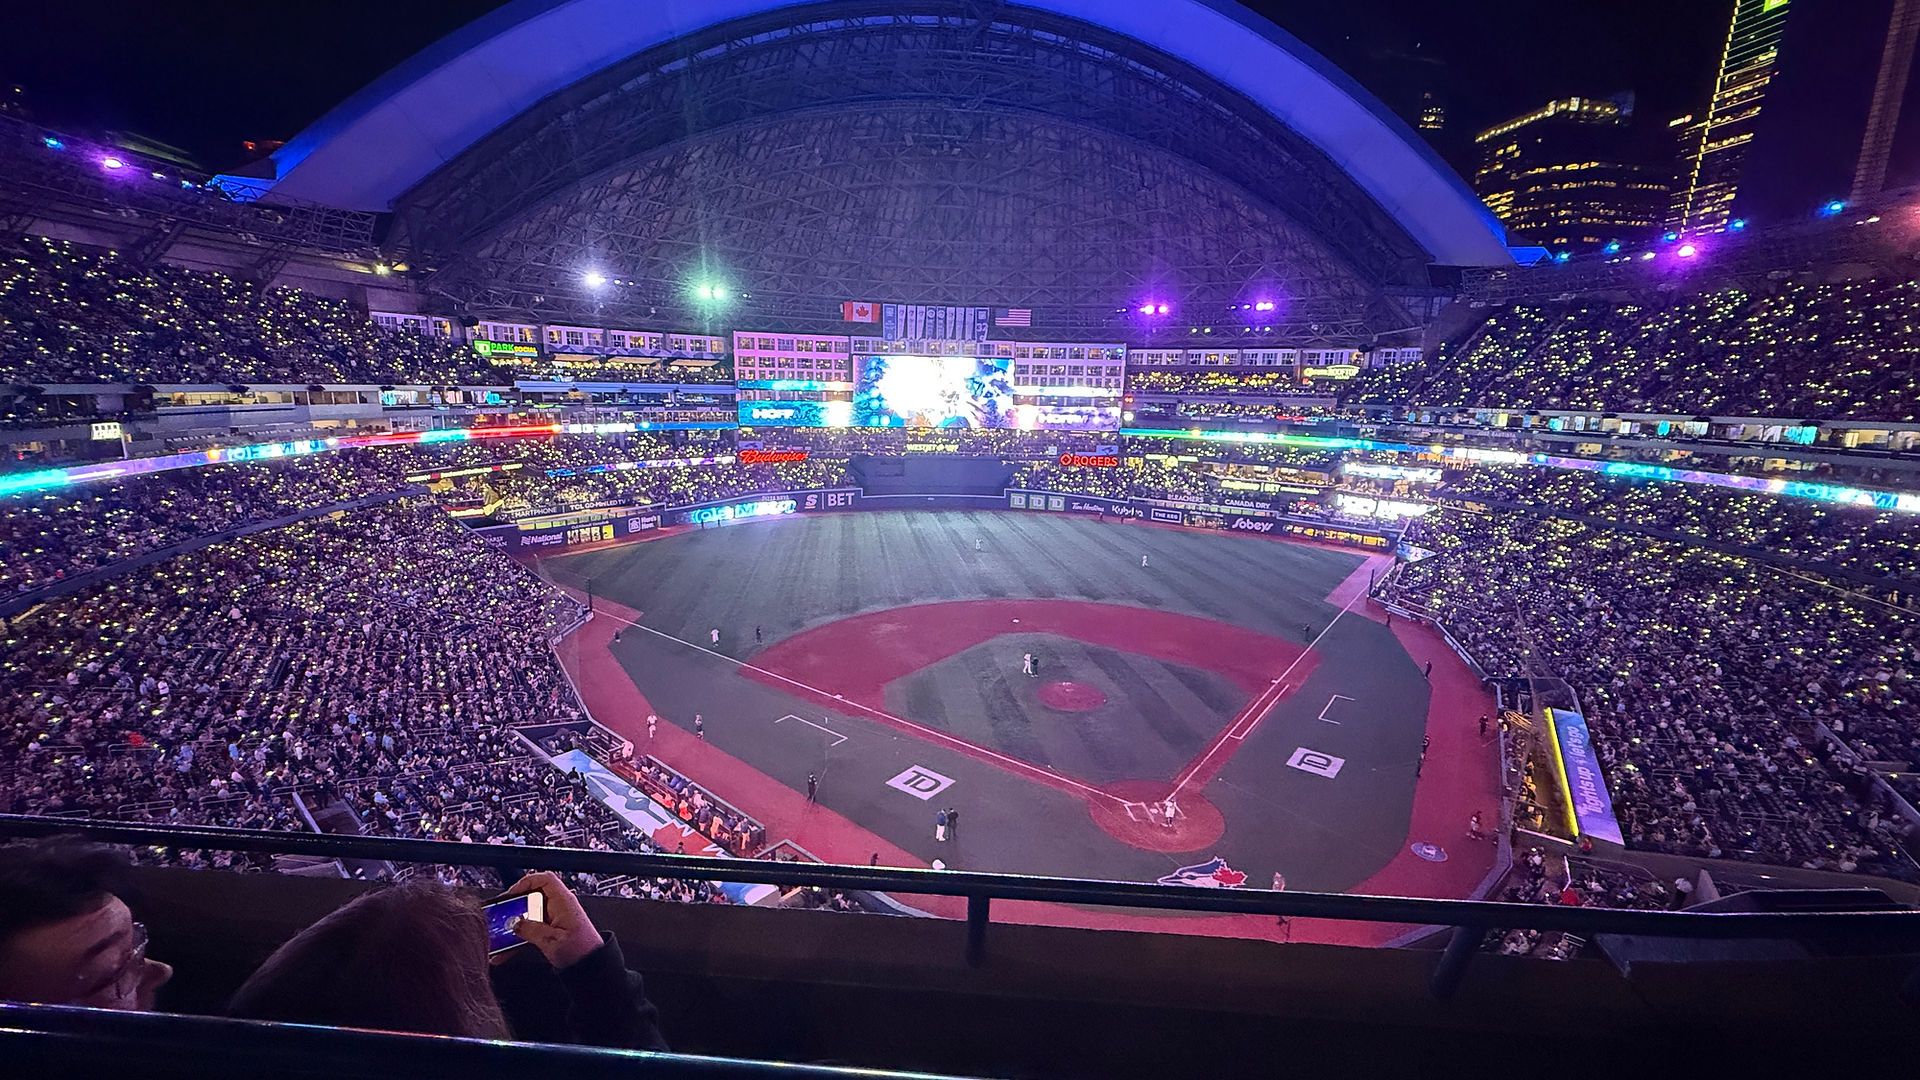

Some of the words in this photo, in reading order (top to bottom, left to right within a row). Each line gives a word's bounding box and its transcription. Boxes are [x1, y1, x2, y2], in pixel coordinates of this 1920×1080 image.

[491, 343, 514, 352] PARK
[740, 449, 809, 464] Budweiser
[1073, 456, 1118, 467] ROGERS
[827, 492, 855, 507] BET
[1167, 493, 1204, 504] BLEACHERS
[1225, 499, 1255, 508] CANADA
[1072, 502, 1082, 510] Tim
[1083, 502, 1105, 512] Hortons
[1232, 517, 1274, 533] Sobeys
[531, 532, 563, 544] National
[1296, 753, 1333, 771] TD
[903, 770, 942, 793] TD
